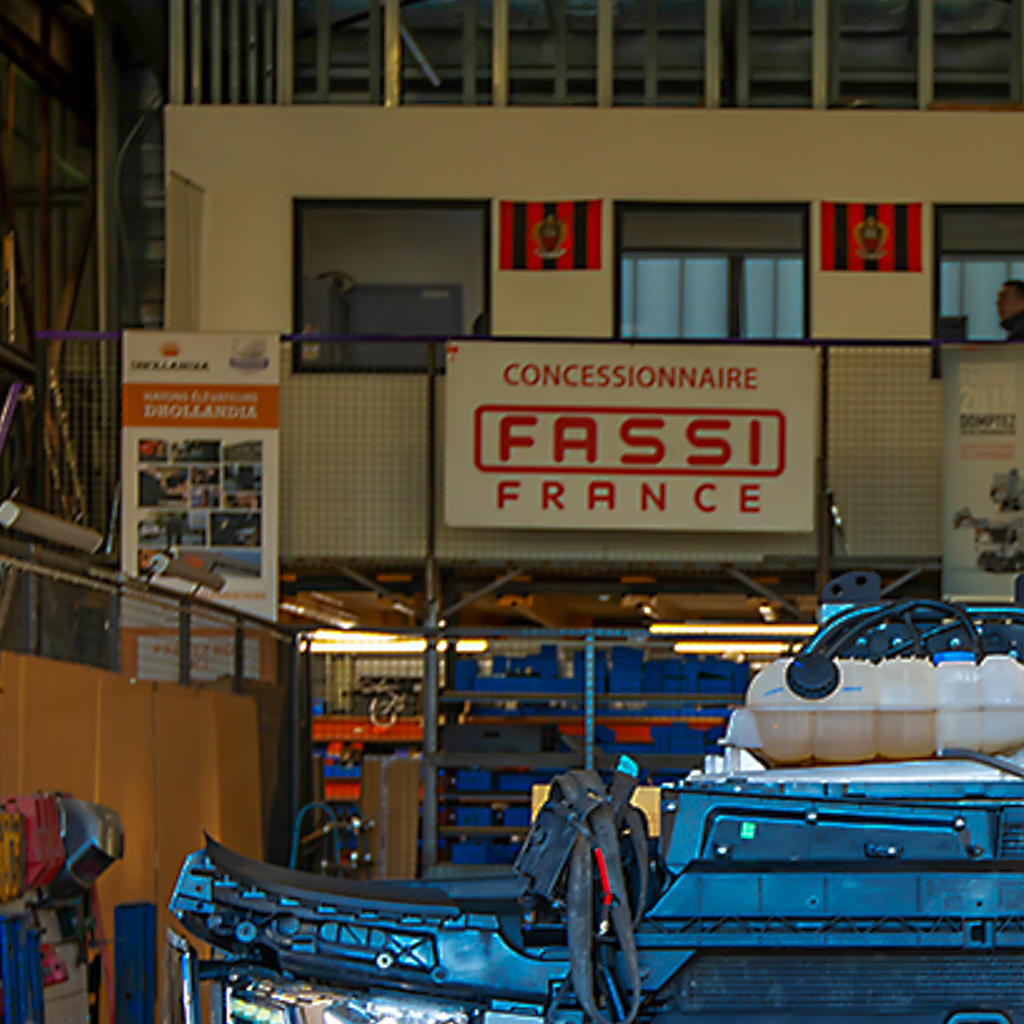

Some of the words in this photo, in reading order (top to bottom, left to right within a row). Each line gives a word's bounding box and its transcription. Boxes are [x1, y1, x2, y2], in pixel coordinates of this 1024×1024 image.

[503, 363, 759, 390] CONCESSIONNAIRE
[143, 404, 258, 419] DHOLLANDIA
[499, 415, 762, 467] FASSI
[497, 481, 761, 513] FRANCE
